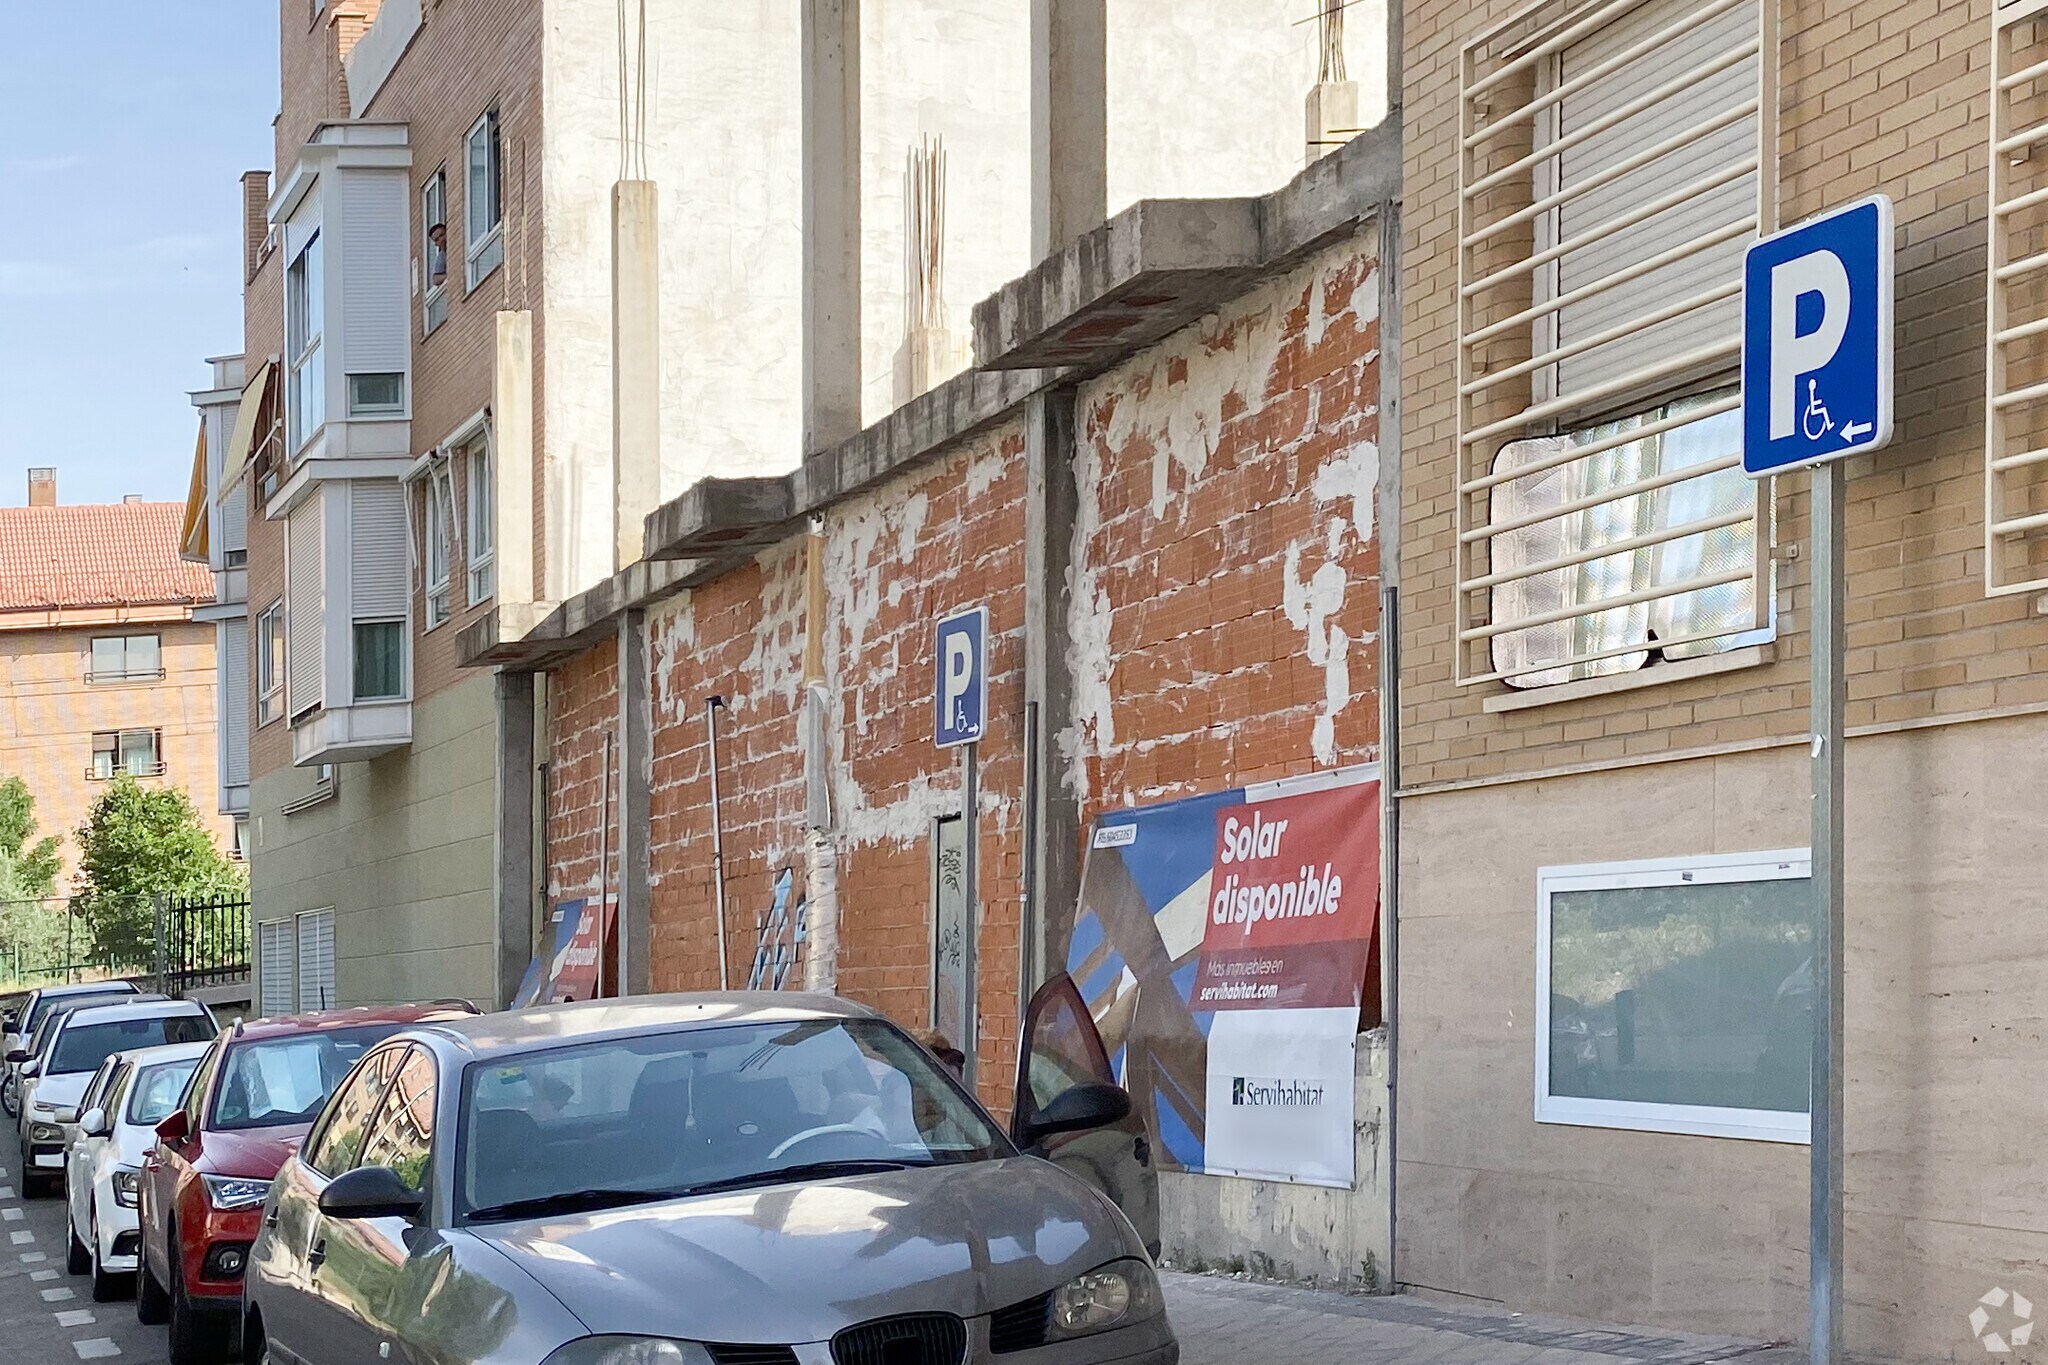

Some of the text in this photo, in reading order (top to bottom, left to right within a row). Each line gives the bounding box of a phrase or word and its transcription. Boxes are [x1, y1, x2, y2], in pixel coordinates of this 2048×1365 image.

[1769, 249, 1851, 442] P
[944, 631, 973, 731] P
[1221, 810, 1288, 864] Solar
[1213, 862, 1342, 935] disponible
[1199, 981, 1279, 1001] servihabitat.com
[1246, 1079, 1324, 1105] Servihabitat
